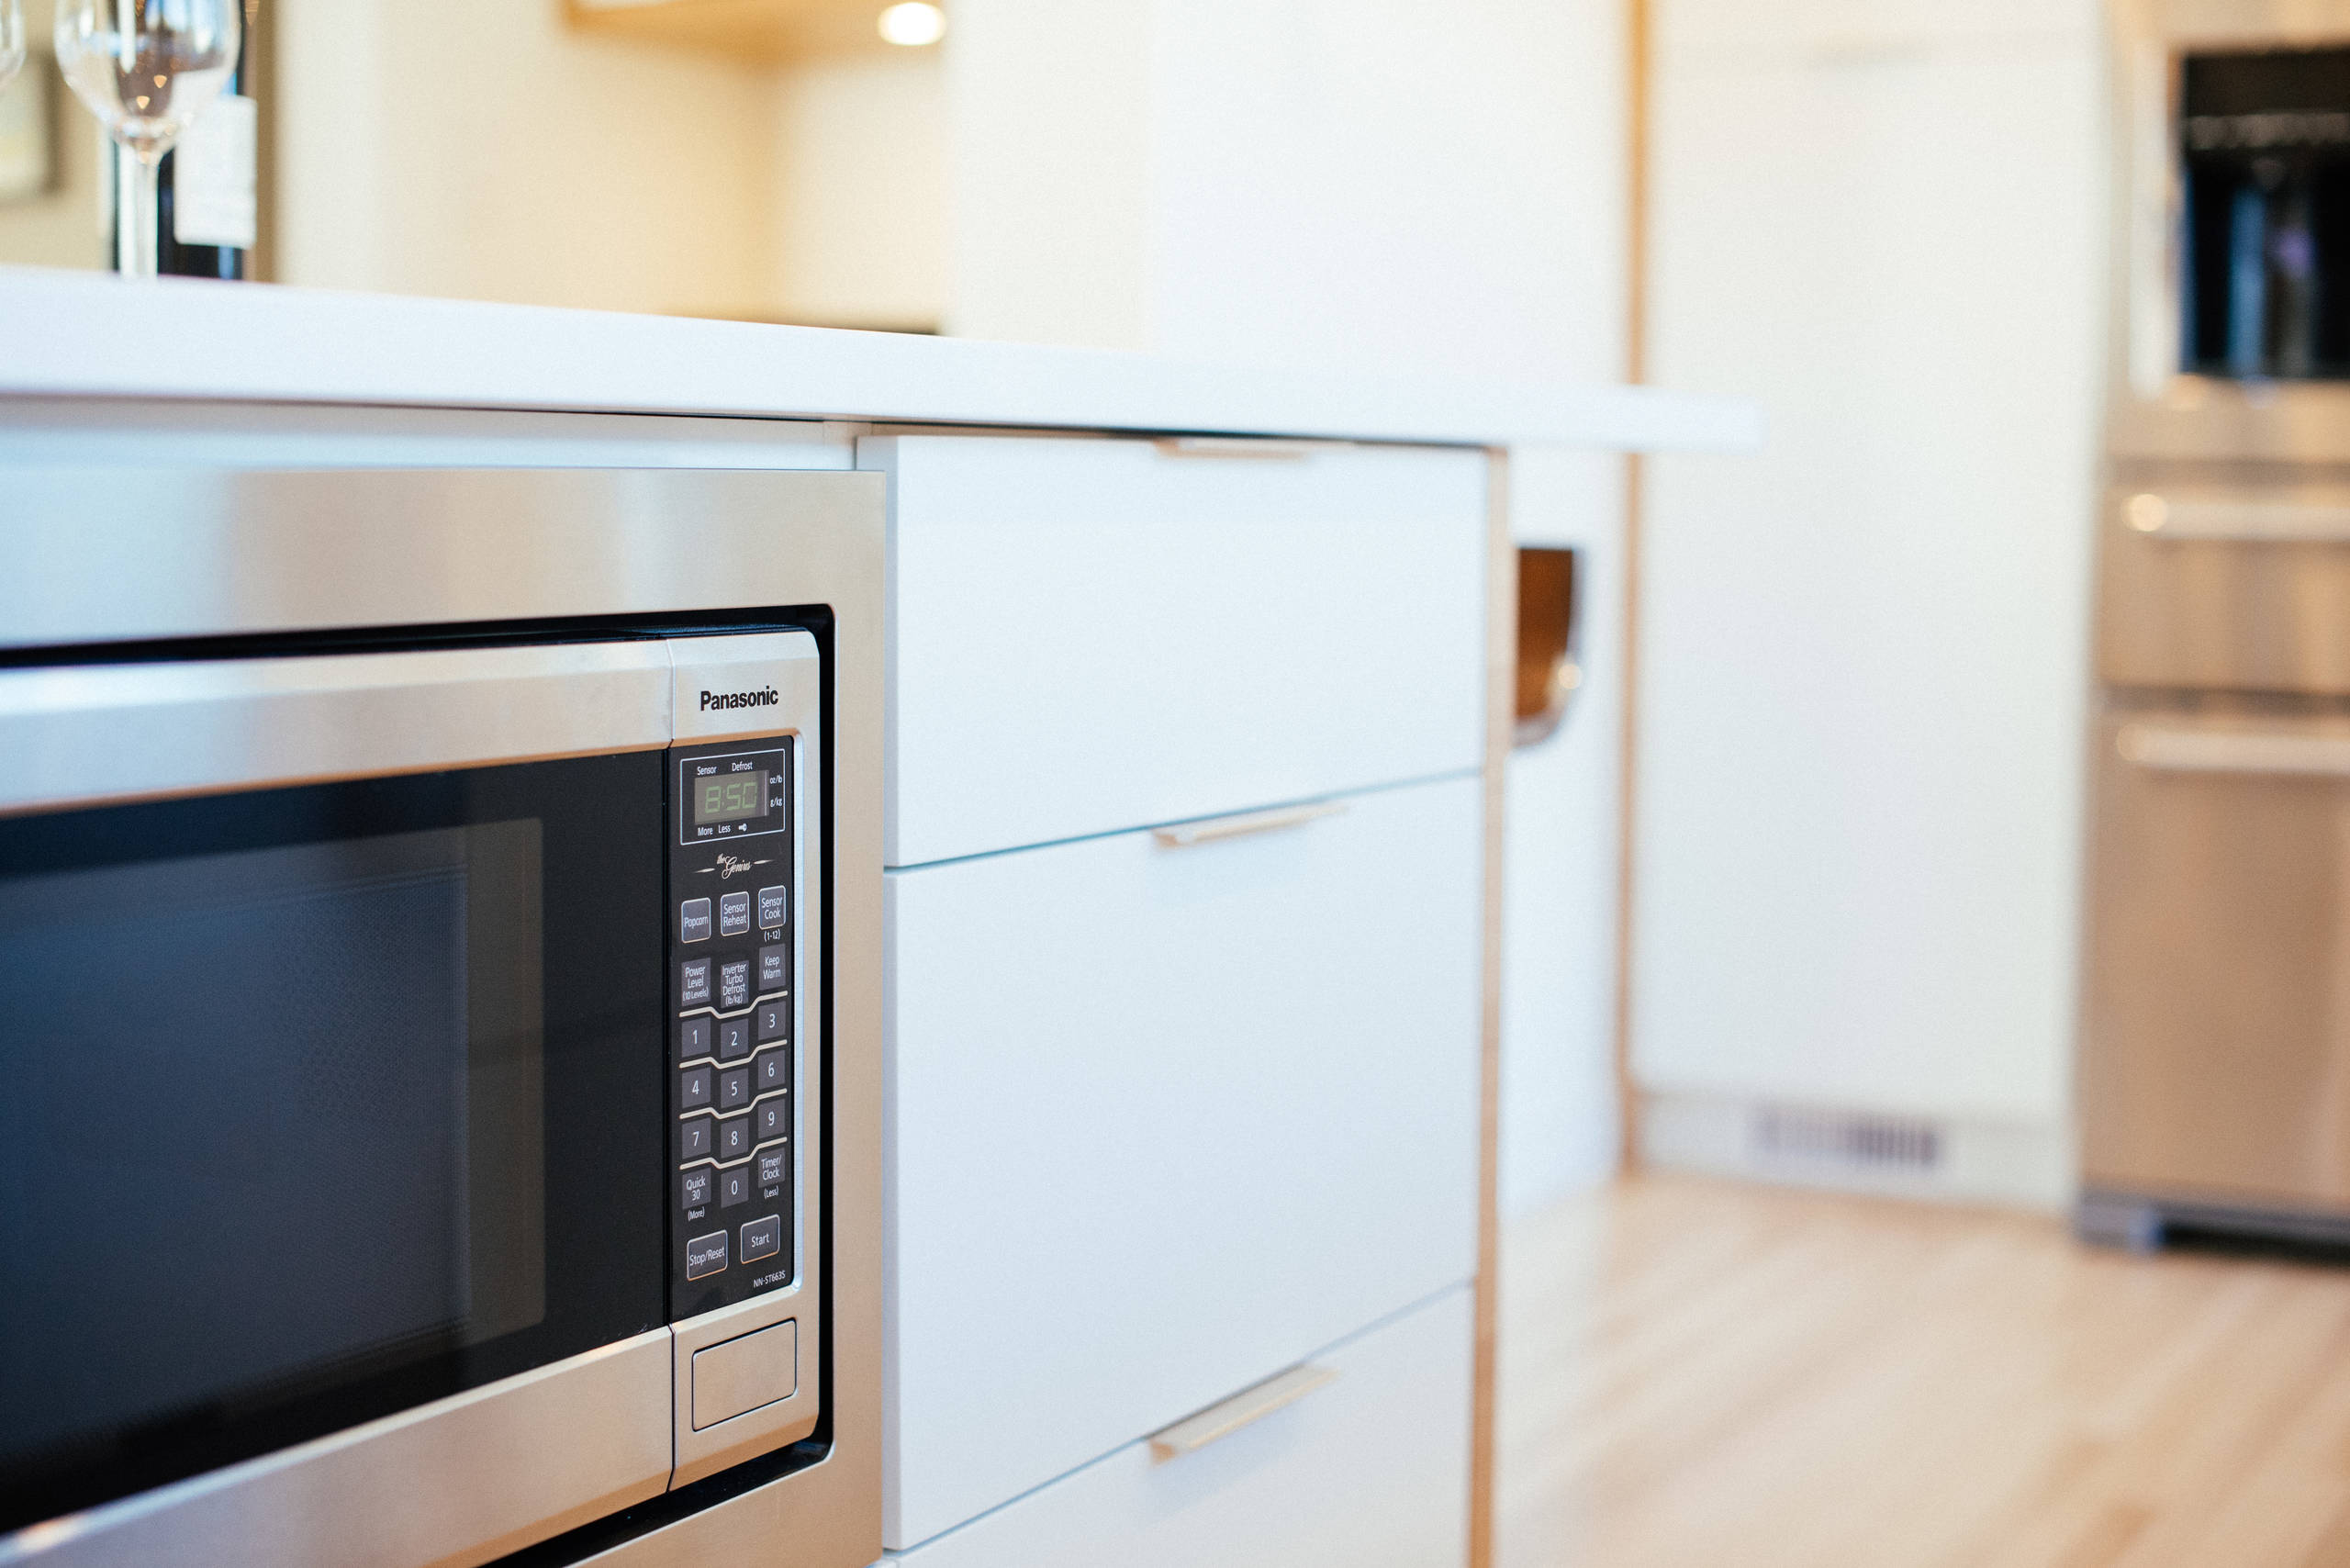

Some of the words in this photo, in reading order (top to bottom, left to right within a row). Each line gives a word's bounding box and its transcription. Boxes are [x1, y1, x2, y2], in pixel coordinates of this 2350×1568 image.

[700, 686, 778, 711] Panasonic
[697, 765, 717, 776] Sensor
[732, 762, 753, 771] Defrost
[770, 775, 782, 784] oz/lb
[704, 782, 757, 814] 8:50
[770, 797, 782, 808] g/kg
[698, 827, 713, 836] More
[718, 823, 731, 834] Less
[722, 856, 751, 879] Genius
[723, 902, 746, 913] Sensor
[762, 896, 782, 908] Sensor
[723, 913, 746, 926] Reheat
[764, 907, 780, 920] Cook
[684, 915, 709, 930] Popcorn
[764, 929, 780, 943] (1-12)
[765, 955, 780, 967] Keep
[685, 965, 705, 977] Power
[722, 963, 746, 975] Inverter
[763, 968, 781, 980] Warm
[688, 976, 704, 989] Level
[725, 974, 744, 985] Turbo
[690, 989, 709, 999] Levels)
[723, 982, 745, 996] Defrost
[769, 1014, 776, 1028] 3
[692, 1030, 698, 1045] 1
[731, 1031, 737, 1046] 2
[768, 1062, 775, 1077] 6
[692, 1080, 699, 1095] 4
[731, 1081, 738, 1096] 5
[768, 1112, 775, 1126] 9
[693, 1131, 699, 1146] 7
[731, 1130, 738, 1146] 8
[761, 1154, 781, 1168] Timer/
[763, 1169, 779, 1181] Clock
[687, 1176, 706, 1191] Quick
[731, 1181, 738, 1195] 0
[692, 1189, 700, 1201] 30
[764, 1185, 779, 1199] (Less)
[688, 1207, 705, 1221] (More)
[751, 1233, 769, 1248] Start
[689, 1246, 724, 1266] Stop/Reset
